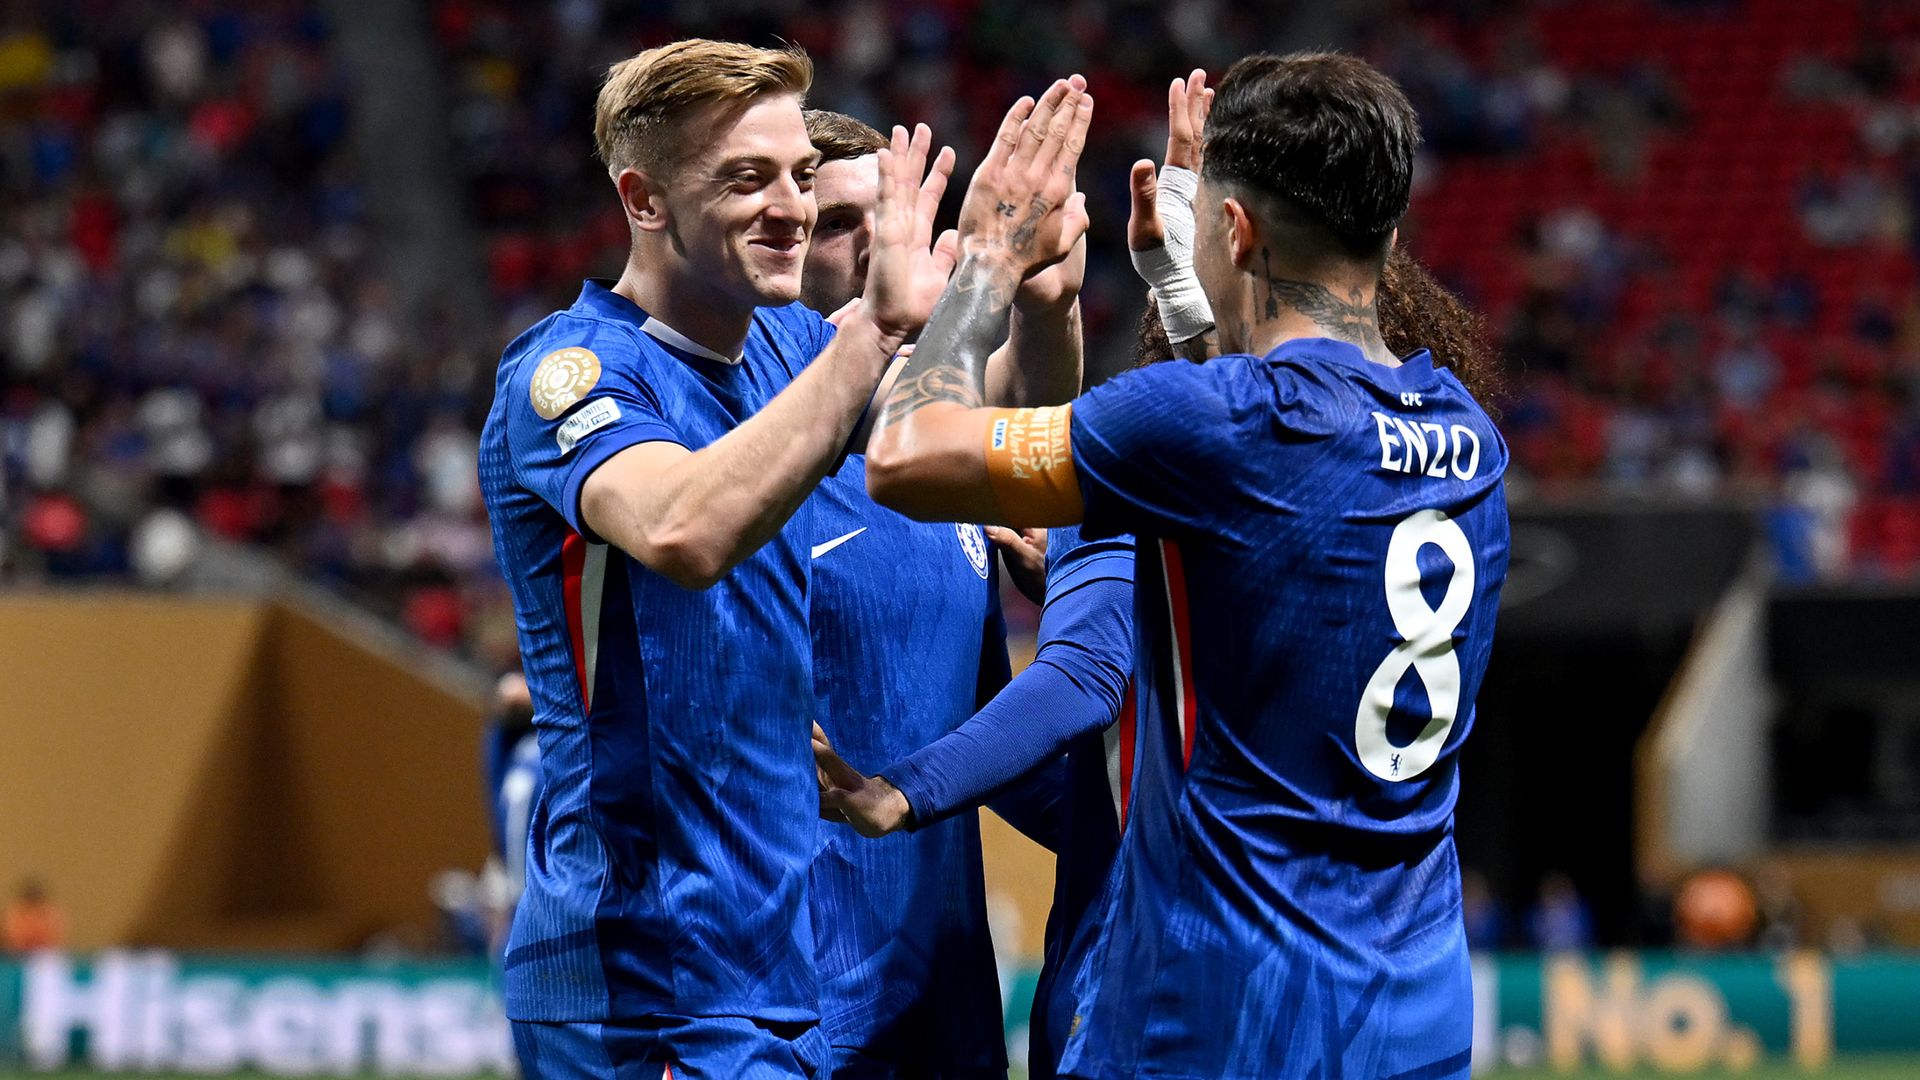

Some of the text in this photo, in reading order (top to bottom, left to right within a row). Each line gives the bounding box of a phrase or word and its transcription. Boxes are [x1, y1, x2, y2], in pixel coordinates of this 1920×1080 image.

[550, 391, 577, 412] FIFA
[1401, 392, 1422, 407] CFC
[994, 421, 1005, 448] FIFA
[1372, 411, 1480, 481] ENZO
[1355, 509, 1475, 782] 8
[1775, 949, 1833, 1069] 1
